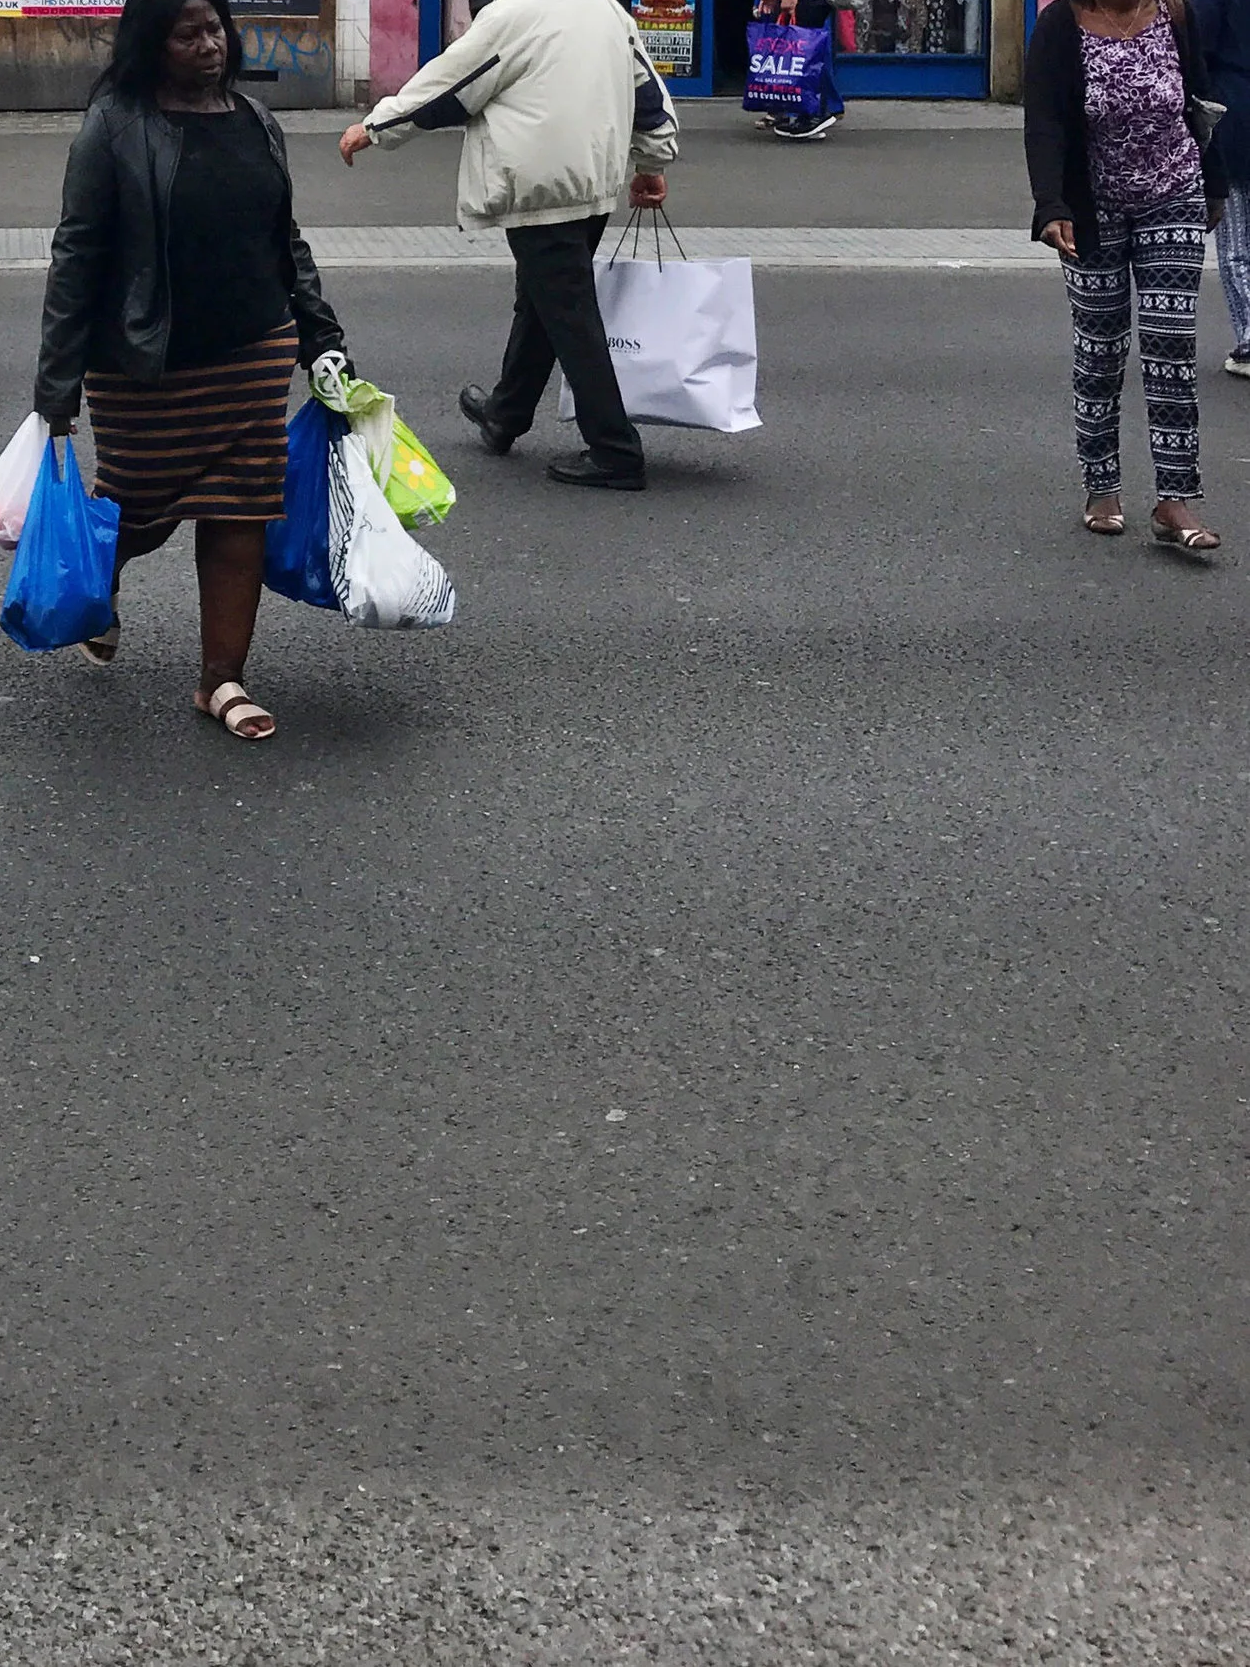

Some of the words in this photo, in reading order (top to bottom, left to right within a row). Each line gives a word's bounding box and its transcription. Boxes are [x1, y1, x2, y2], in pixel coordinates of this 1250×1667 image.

[750, 54, 805, 76] SALE
[782, 94, 802, 102] LESS
[608, 337, 641, 350] BOSS
